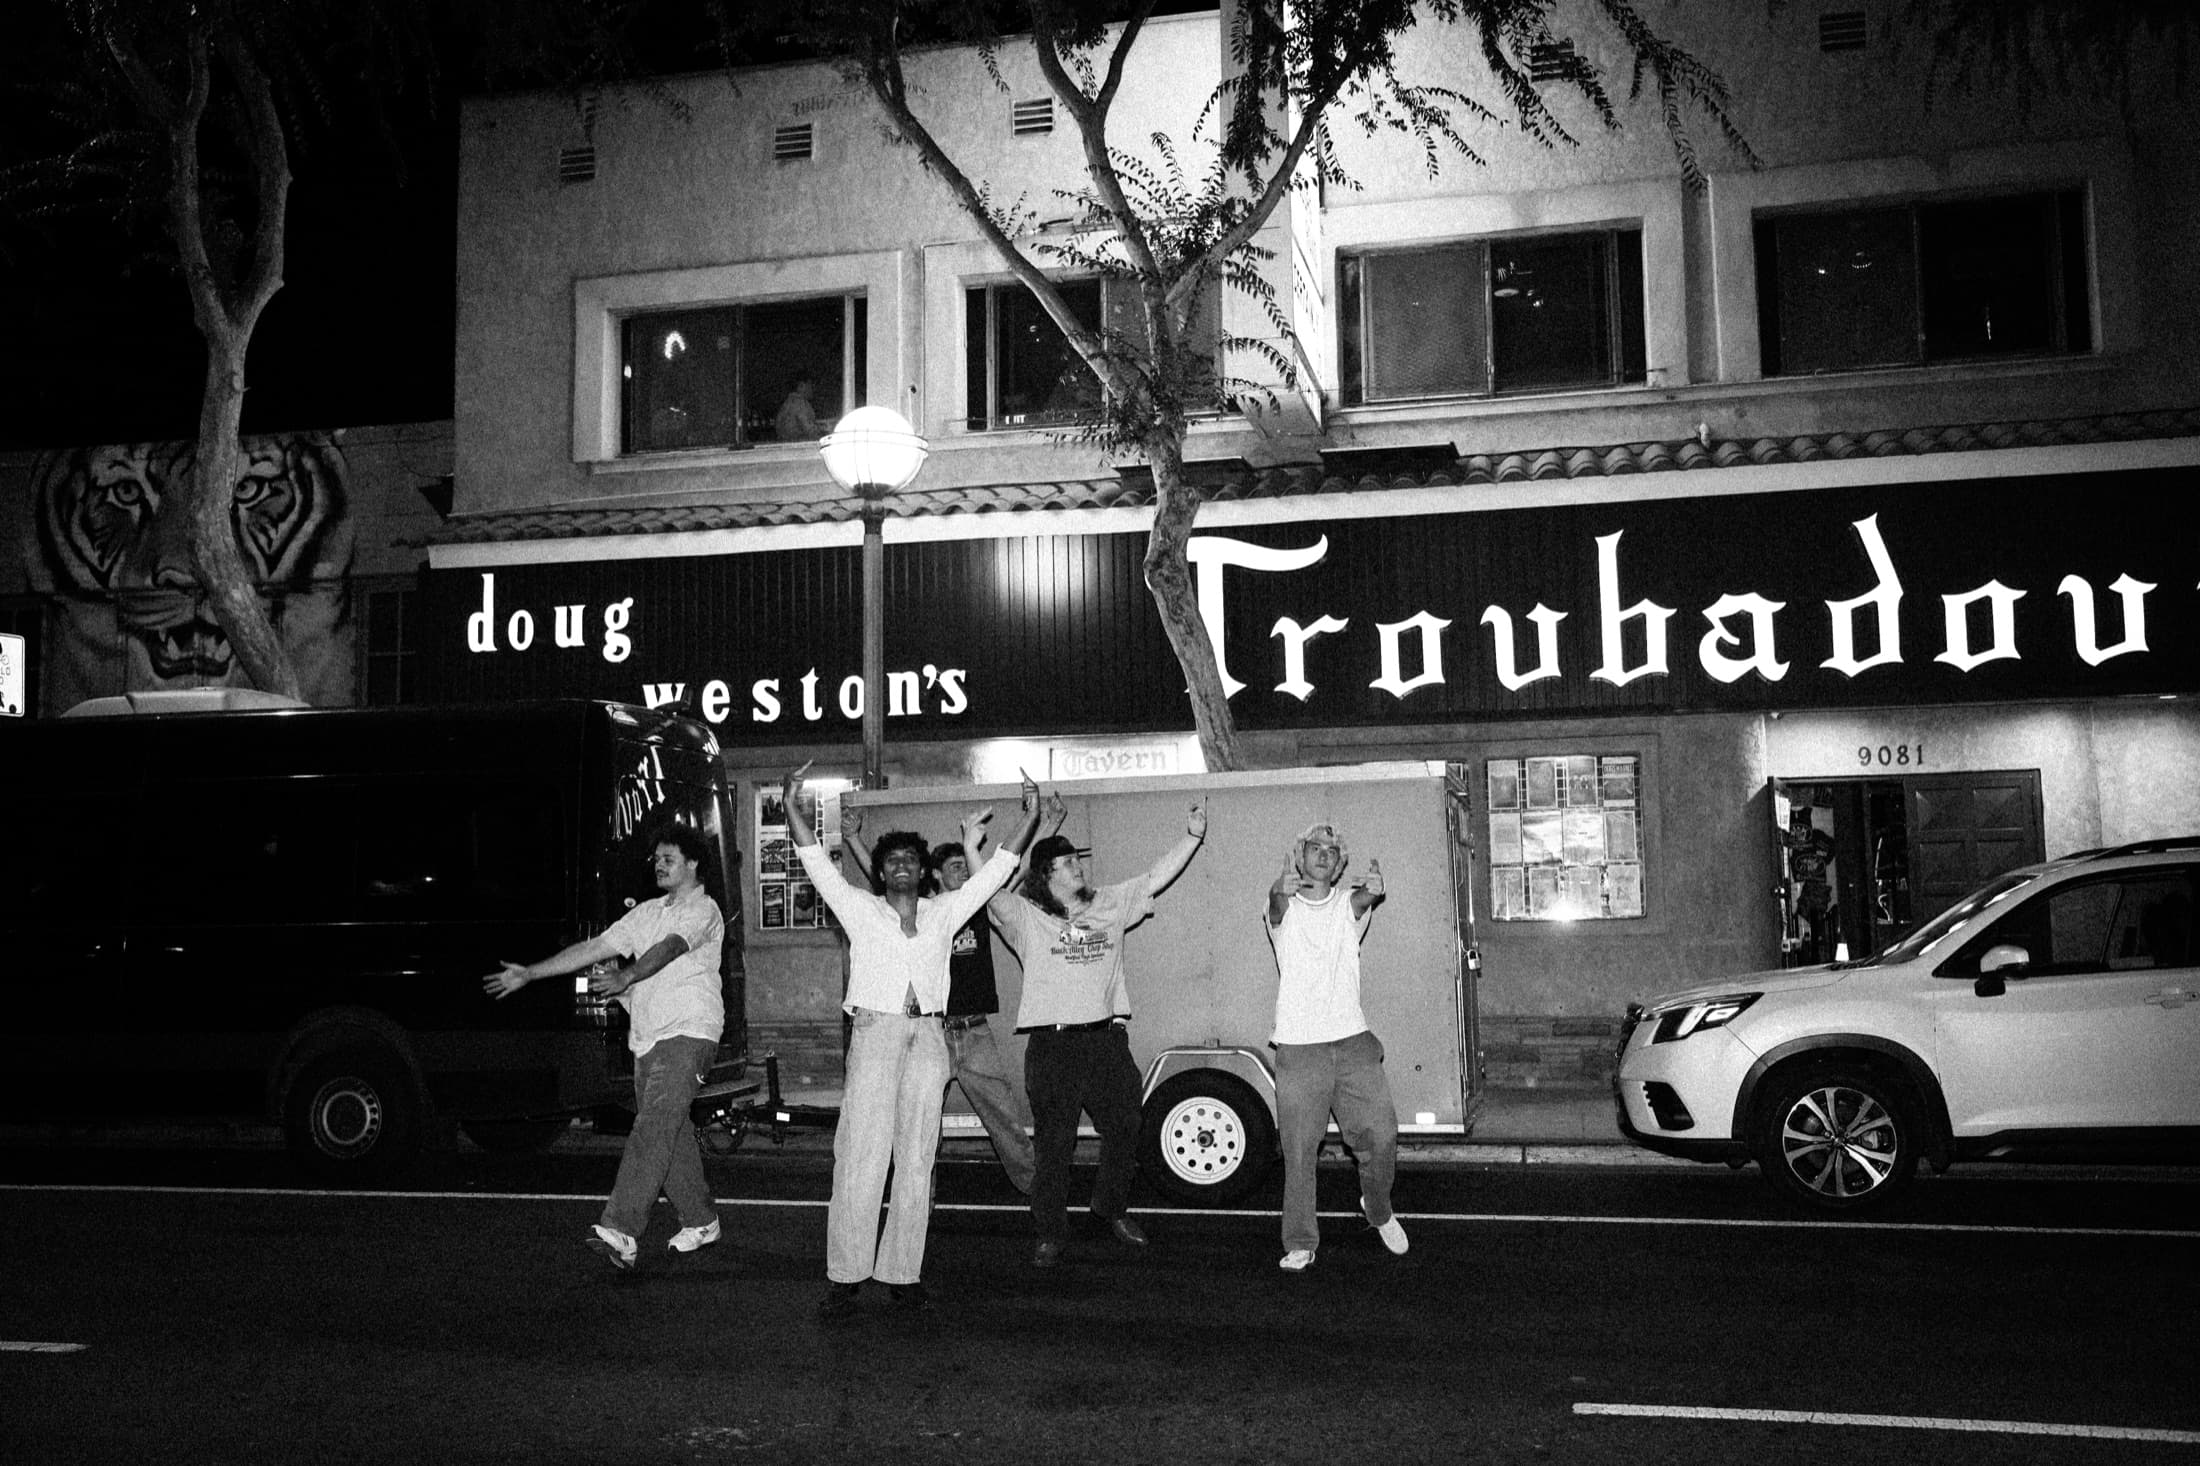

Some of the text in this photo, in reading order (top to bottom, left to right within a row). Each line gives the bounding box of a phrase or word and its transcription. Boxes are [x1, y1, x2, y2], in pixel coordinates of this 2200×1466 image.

[467, 573, 634, 663] doug
[1146, 513, 2200, 703] Troubadou
[642, 664, 968, 723] weston's
[1060, 749, 1167, 777] Tavern
[1857, 743, 1924, 767] 9081
